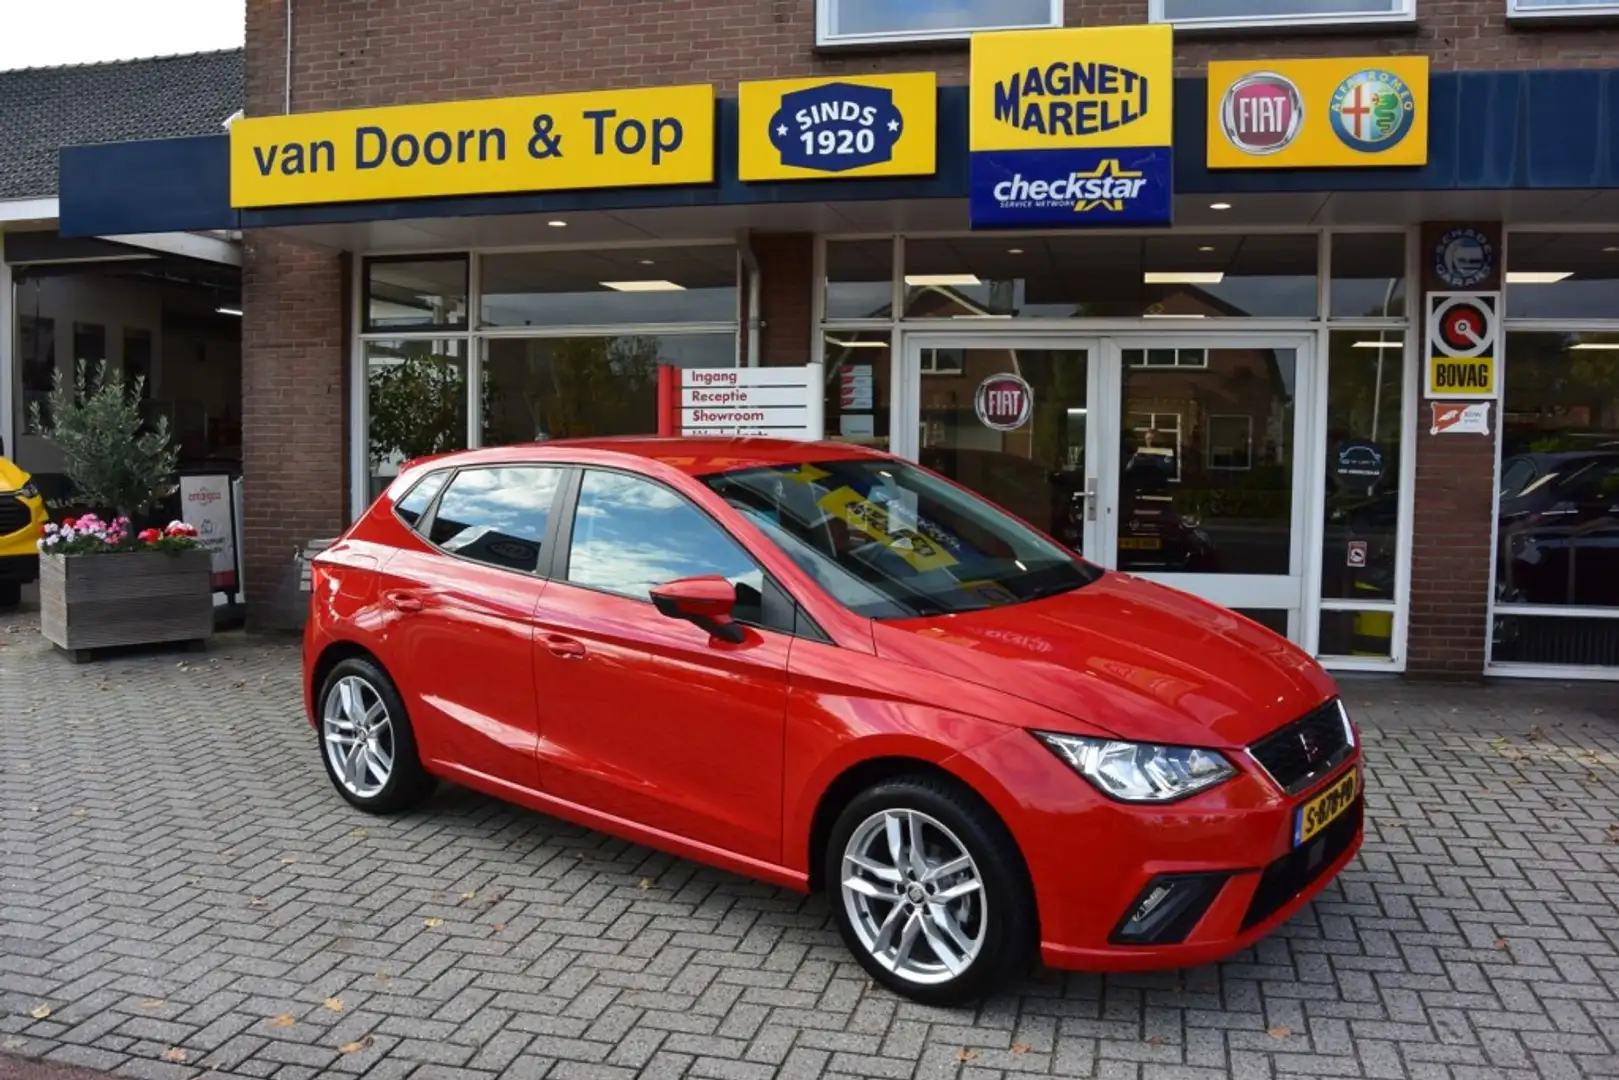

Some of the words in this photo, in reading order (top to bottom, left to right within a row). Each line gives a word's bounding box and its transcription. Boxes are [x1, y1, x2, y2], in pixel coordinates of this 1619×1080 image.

[995, 62, 1147, 113] MAGNETI
[795, 101, 877, 130] SINDS
[995, 87, 1147, 136] MARELLI
[1239, 97, 1286, 133] FIAT
[253, 140, 335, 176] van
[356, 126, 505, 170] Doorn
[528, 114, 563, 159] &
[583, 109, 683, 165] Top
[800, 129, 875, 155] 1920
[993, 172, 1147, 200] checkstar
[1000, 200, 1032, 208] SERVICE
[1035, 199, 1075, 207] NETWORK
[692, 370, 737, 385] Ingang
[1436, 363, 1488, 387] BOVAG
[692, 389, 748, 404] Receptie
[988, 390, 1021, 416] FIAT
[693, 409, 764, 422] Showroom
